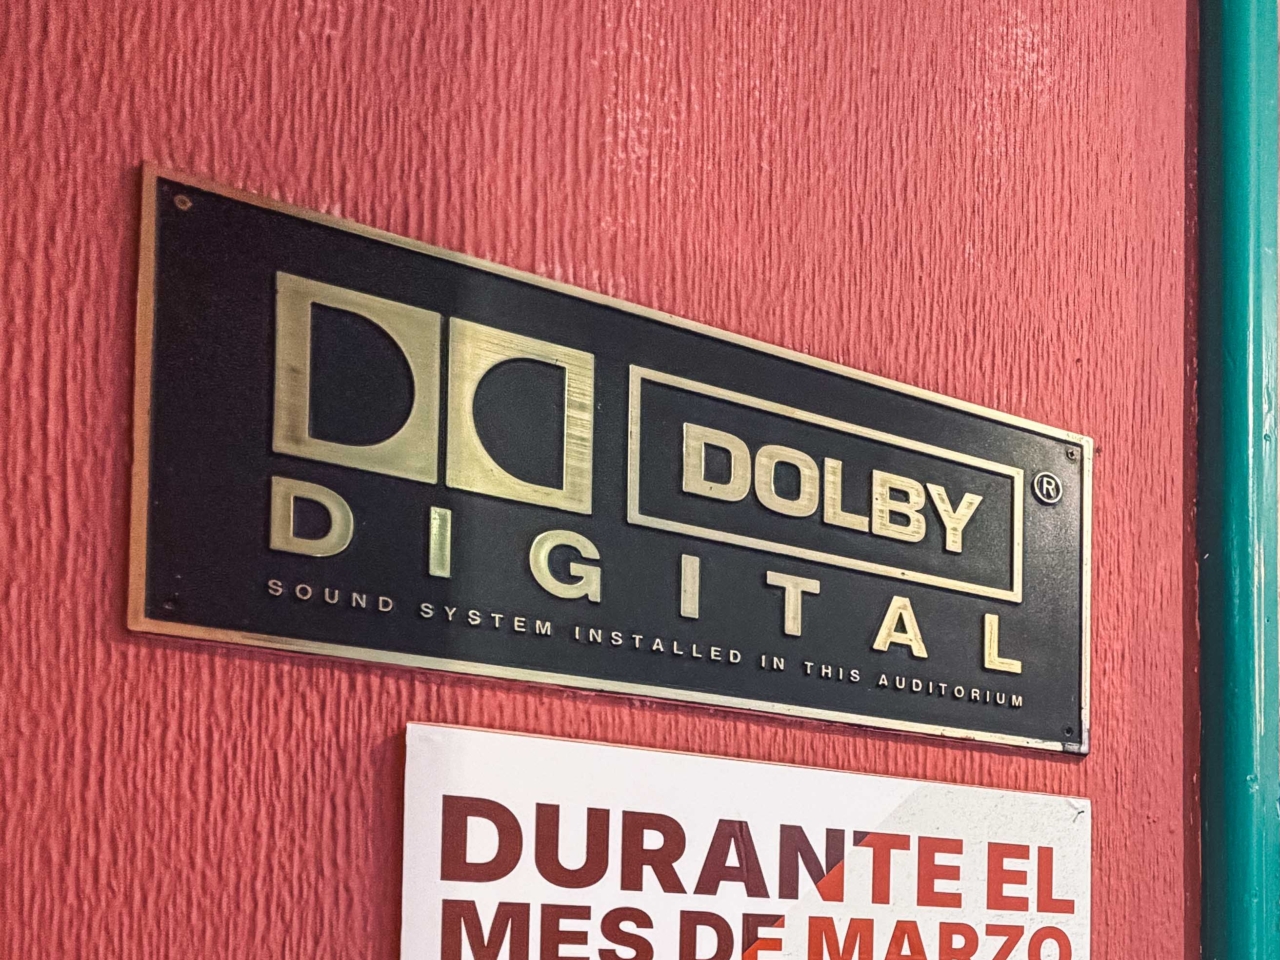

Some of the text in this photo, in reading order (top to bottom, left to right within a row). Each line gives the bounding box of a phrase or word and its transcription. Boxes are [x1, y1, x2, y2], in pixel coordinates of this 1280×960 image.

[682, 420, 983, 553] DOLBY
[269, 475, 1023, 675] DIGITAL
[267, 578, 1024, 708] SOUND SYSTEM INSTALLED IN THIS AUDITORIUM
[439, 793, 1076, 914] DURANTE EL
